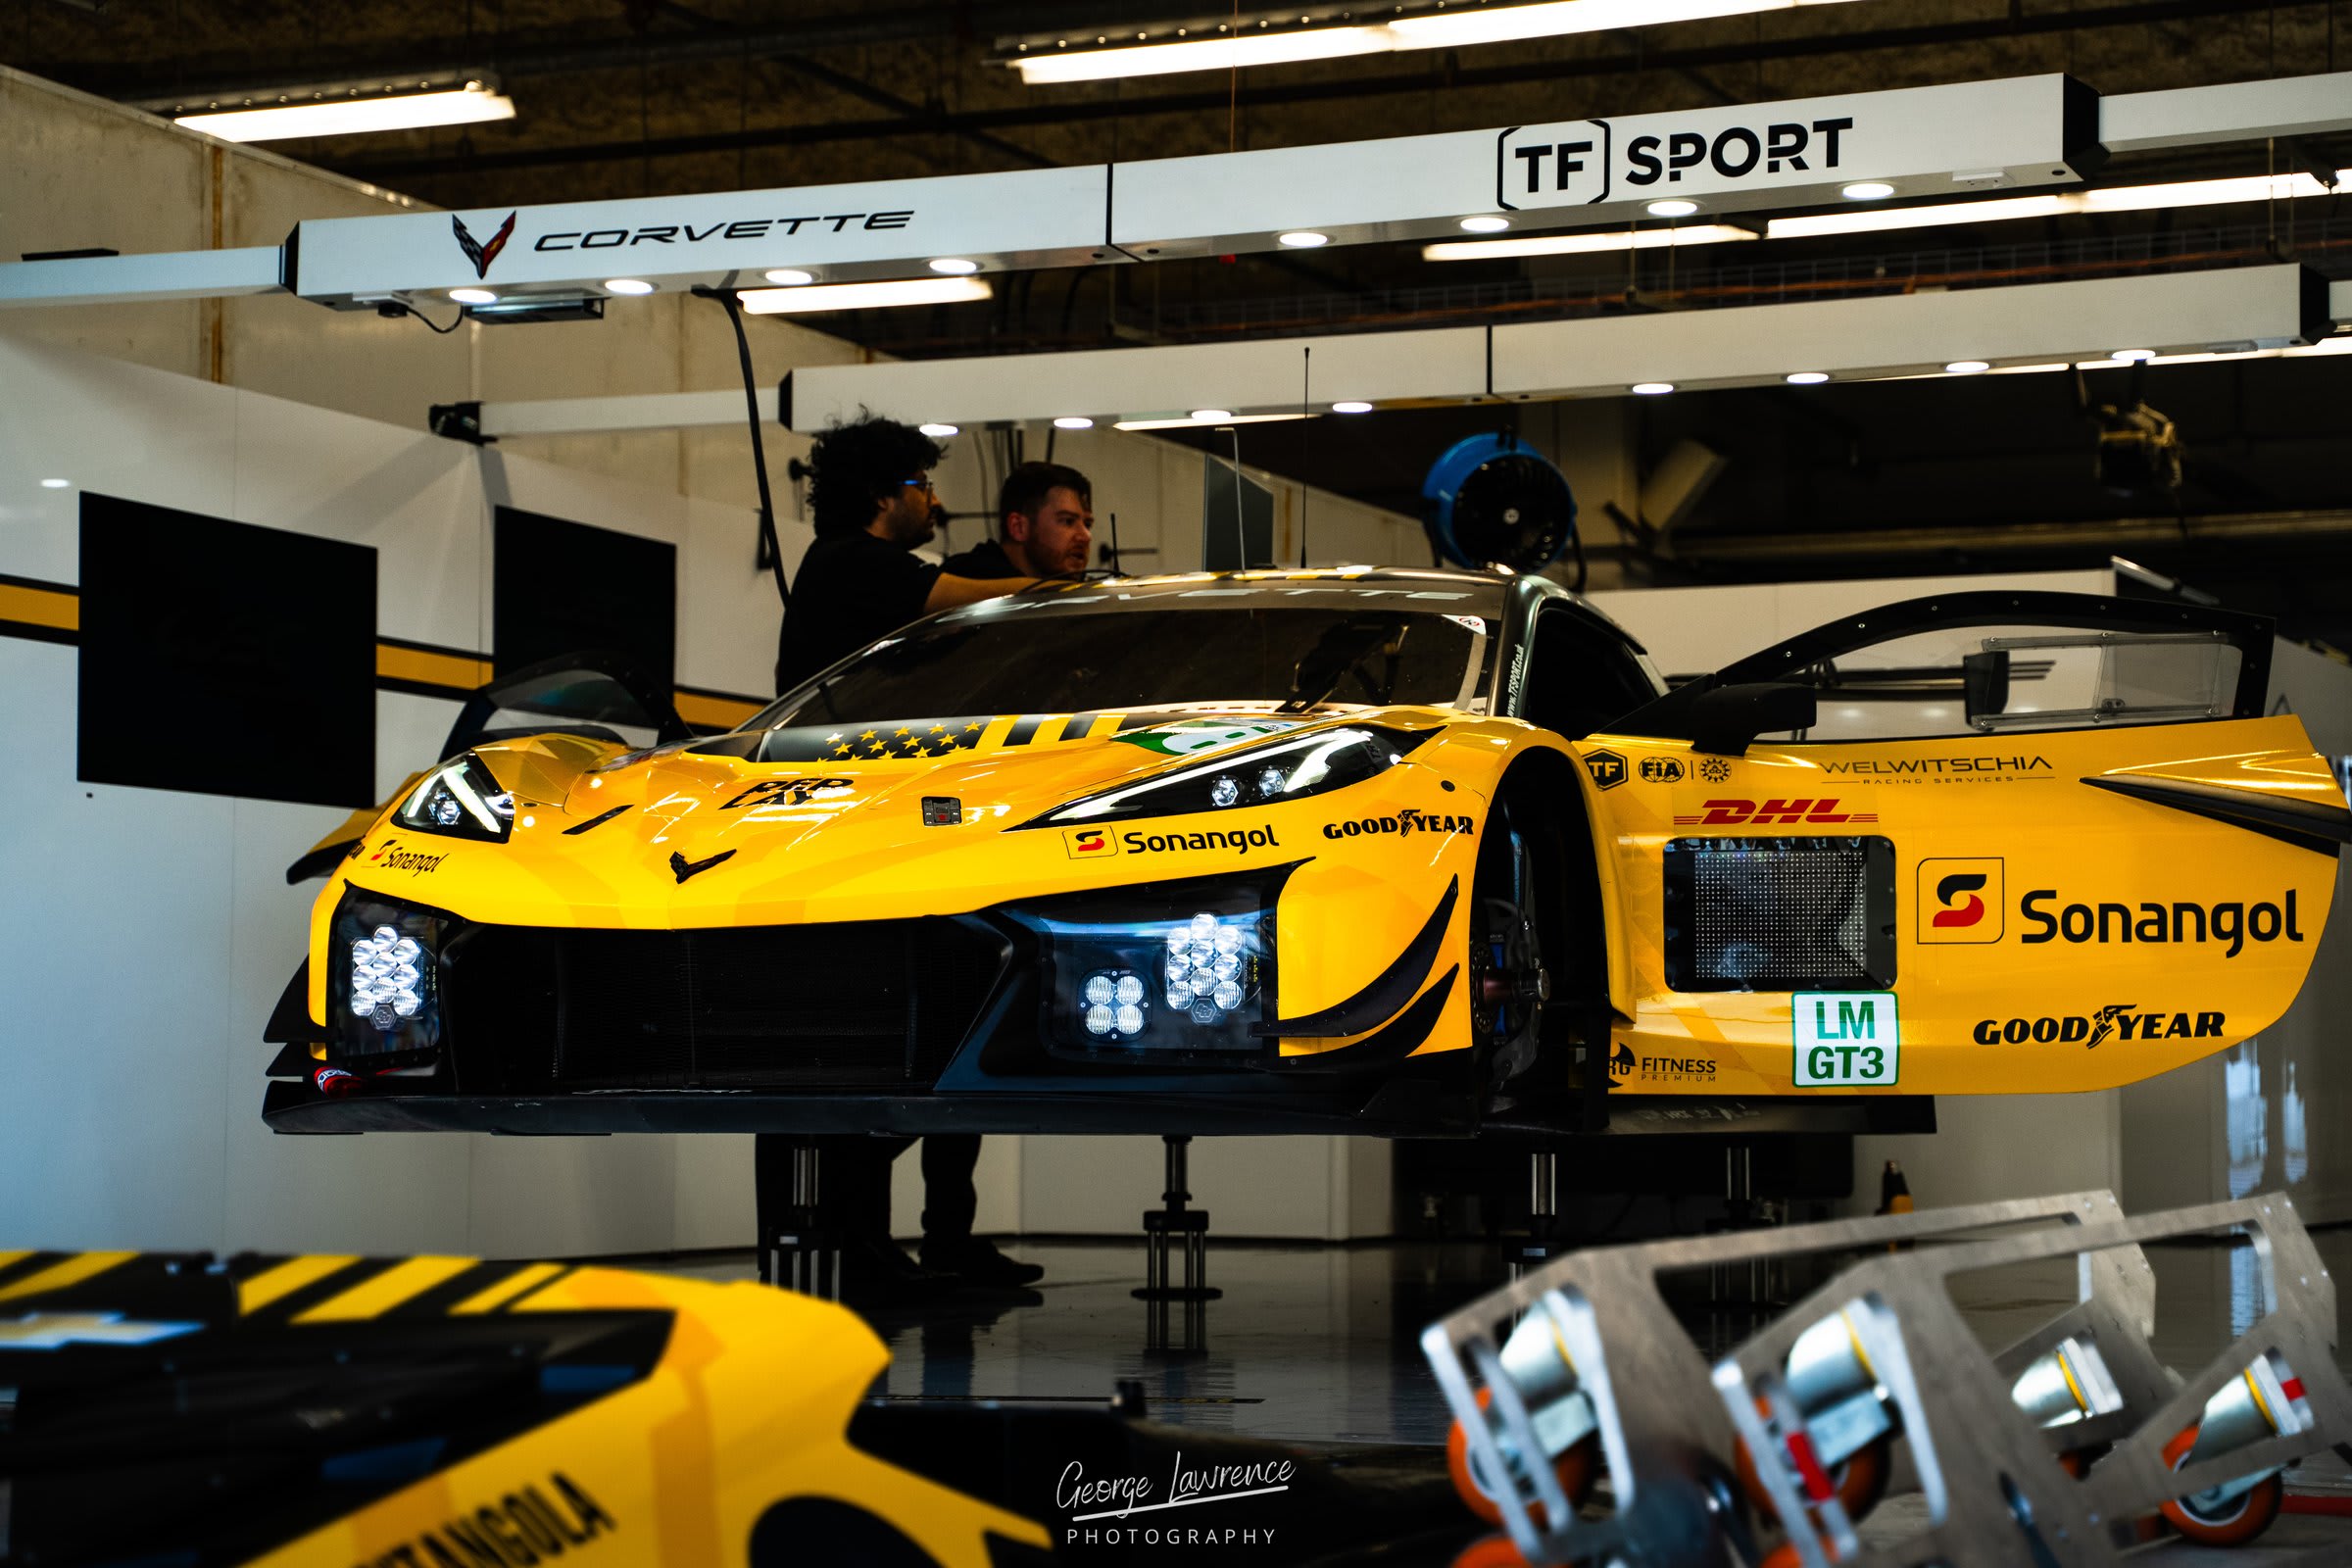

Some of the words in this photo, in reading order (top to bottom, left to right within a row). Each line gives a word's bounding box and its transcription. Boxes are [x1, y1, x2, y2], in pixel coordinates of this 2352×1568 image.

[1515, 141, 1592, 193] TF
[1625, 117, 1853, 185] SPORT
[534, 210, 915, 251] CORVETTE
[1589, 760, 1619, 777] TF
[1819, 756, 2053, 774] WELWITSCHIA
[1701, 799, 1850, 824] DHL
[1123, 824, 1280, 856] Sonangol
[380, 847, 450, 877] Sonangol
[2020, 888, 2304, 959] Sonangol
[1815, 1001, 1876, 1040] LM
[1642, 1057, 1716, 1073] FITNESS
[1807, 1046, 1885, 1079] GT3
[1641, 1074, 1716, 1083] PREMIUM
